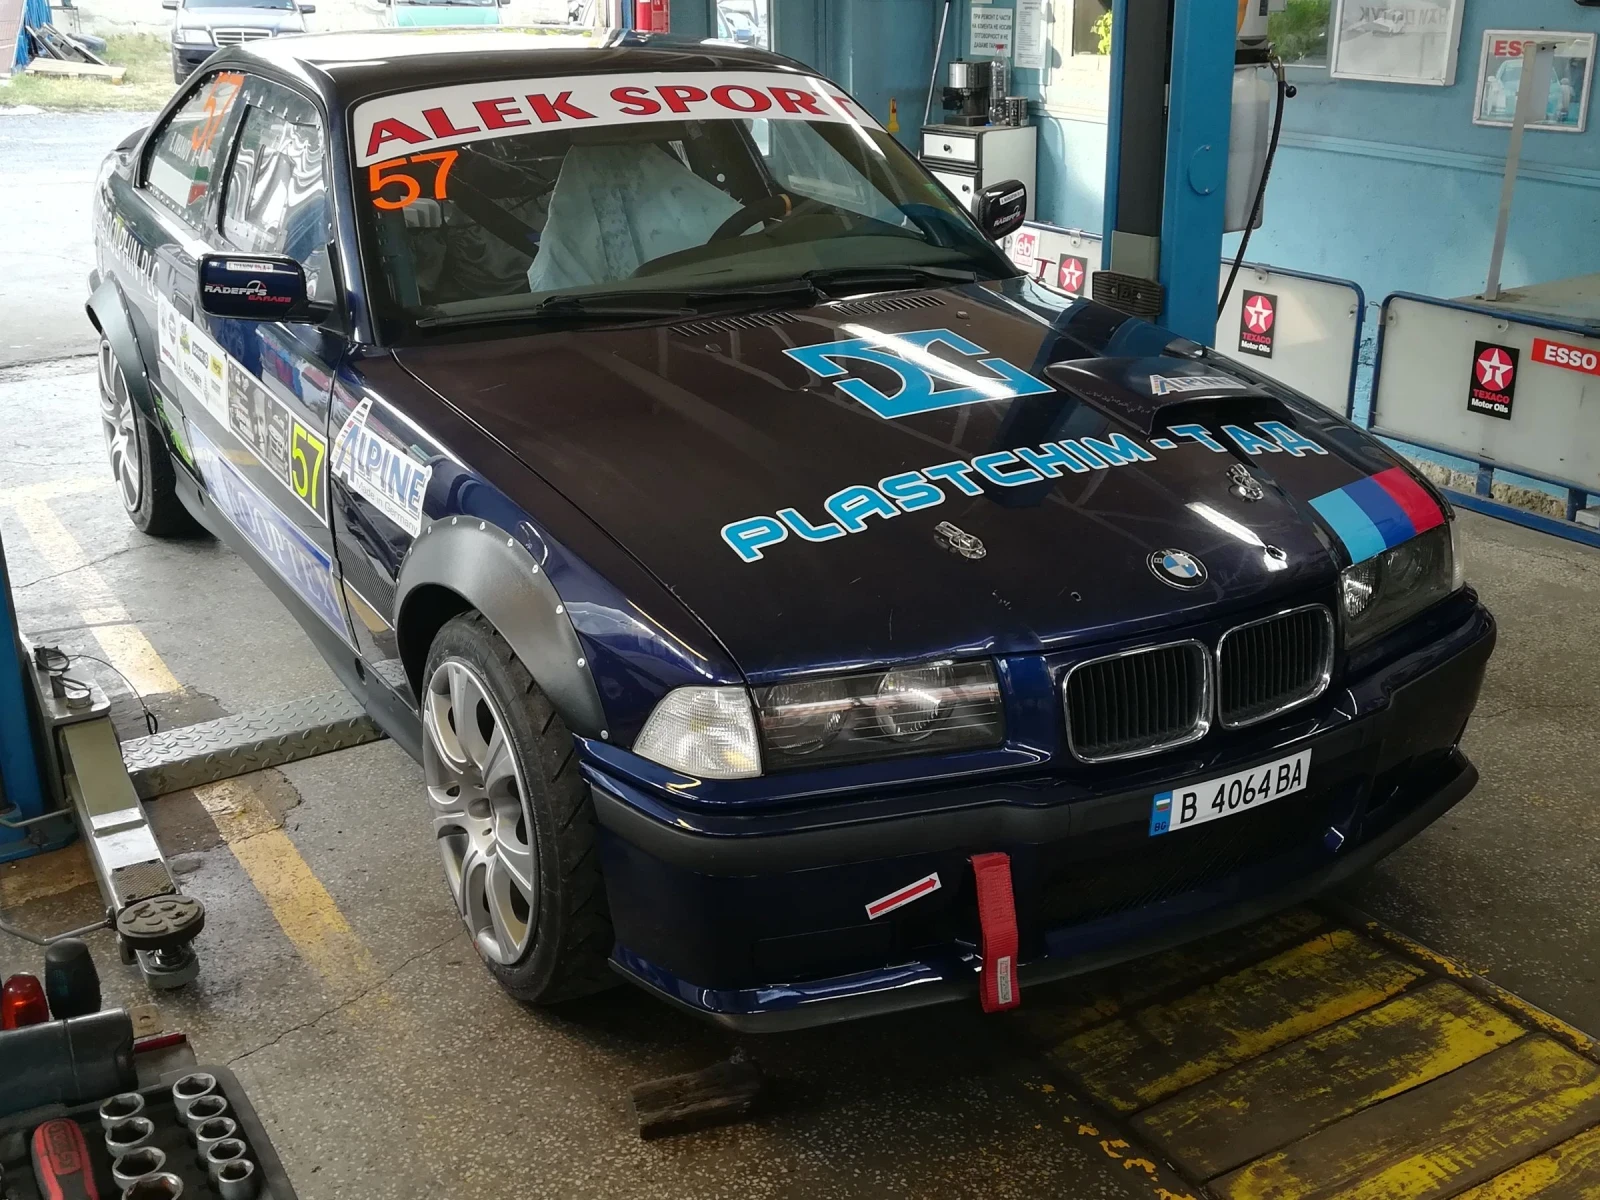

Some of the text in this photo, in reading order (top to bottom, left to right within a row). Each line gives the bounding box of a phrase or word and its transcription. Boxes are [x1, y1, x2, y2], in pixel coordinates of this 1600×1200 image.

[365, 84, 859, 157] ALEK SPORT
[369, 151, 459, 210] 57
[248, 295, 292, 303] GARAGE
[1241, 340, 1271, 353] Motor Oils
[1242, 332, 1271, 345] TEXACO
[1544, 344, 1597, 370] ESSO
[1471, 398, 1509, 413] Motor Oils
[1473, 388, 1510, 404] TEXACO
[292, 422, 325, 509] 57
[336, 423, 426, 520] ALPINE
[355, 478, 376, 499] Made
[384, 501, 418, 535] Germany
[1180, 758, 1302, 824] B 4064 BA
[1154, 821, 1167, 832] BG
